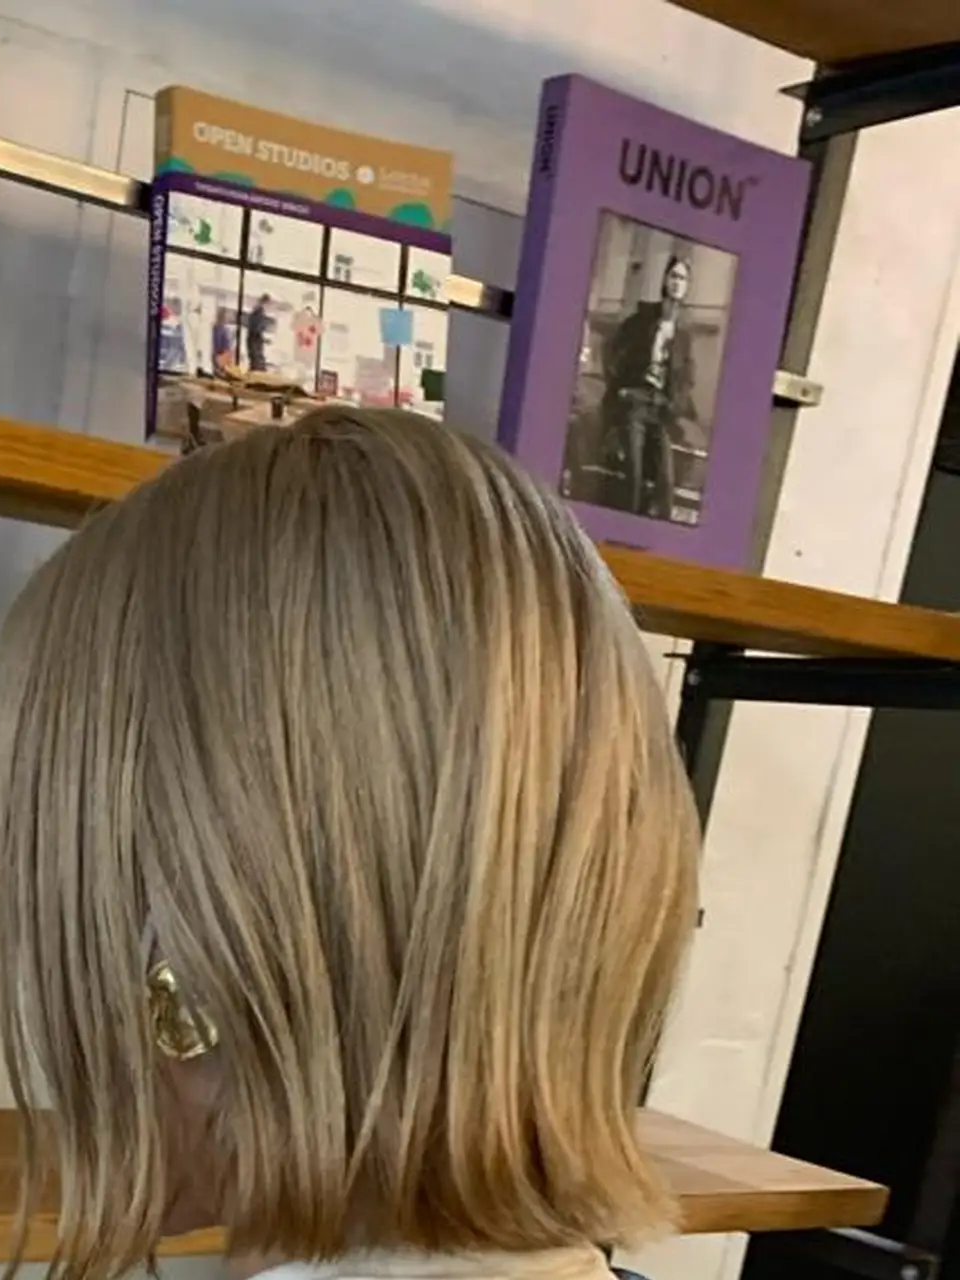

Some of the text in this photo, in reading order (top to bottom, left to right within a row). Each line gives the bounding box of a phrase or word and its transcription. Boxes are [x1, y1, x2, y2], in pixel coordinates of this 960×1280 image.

[193, 121, 253, 155] OPEN
[255, 139, 350, 181] STUDIOS
[619, 138, 746, 221] UNION
